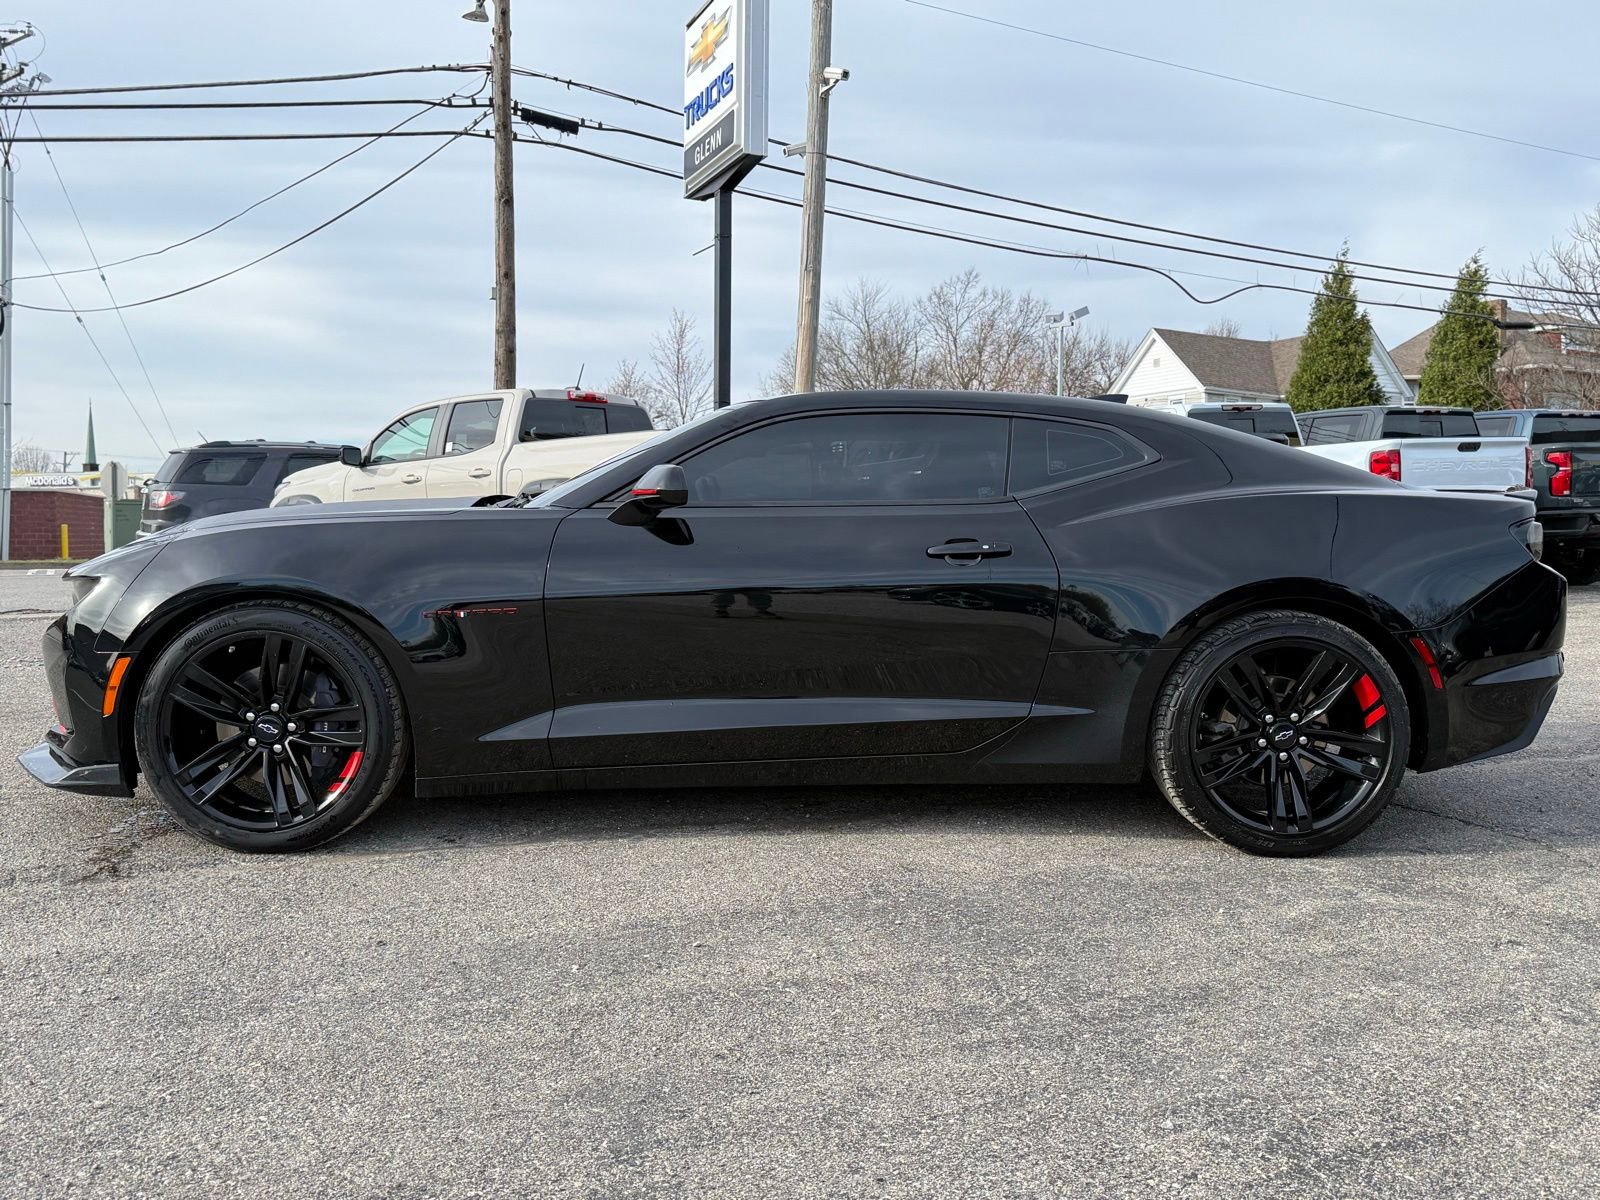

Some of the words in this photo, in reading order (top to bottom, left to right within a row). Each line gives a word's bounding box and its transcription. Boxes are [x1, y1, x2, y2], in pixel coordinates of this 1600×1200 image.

[684, 62, 733, 130] TRUCKS
[694, 128, 722, 165] GLENN
[25, 476, 74, 487] McDonald's
